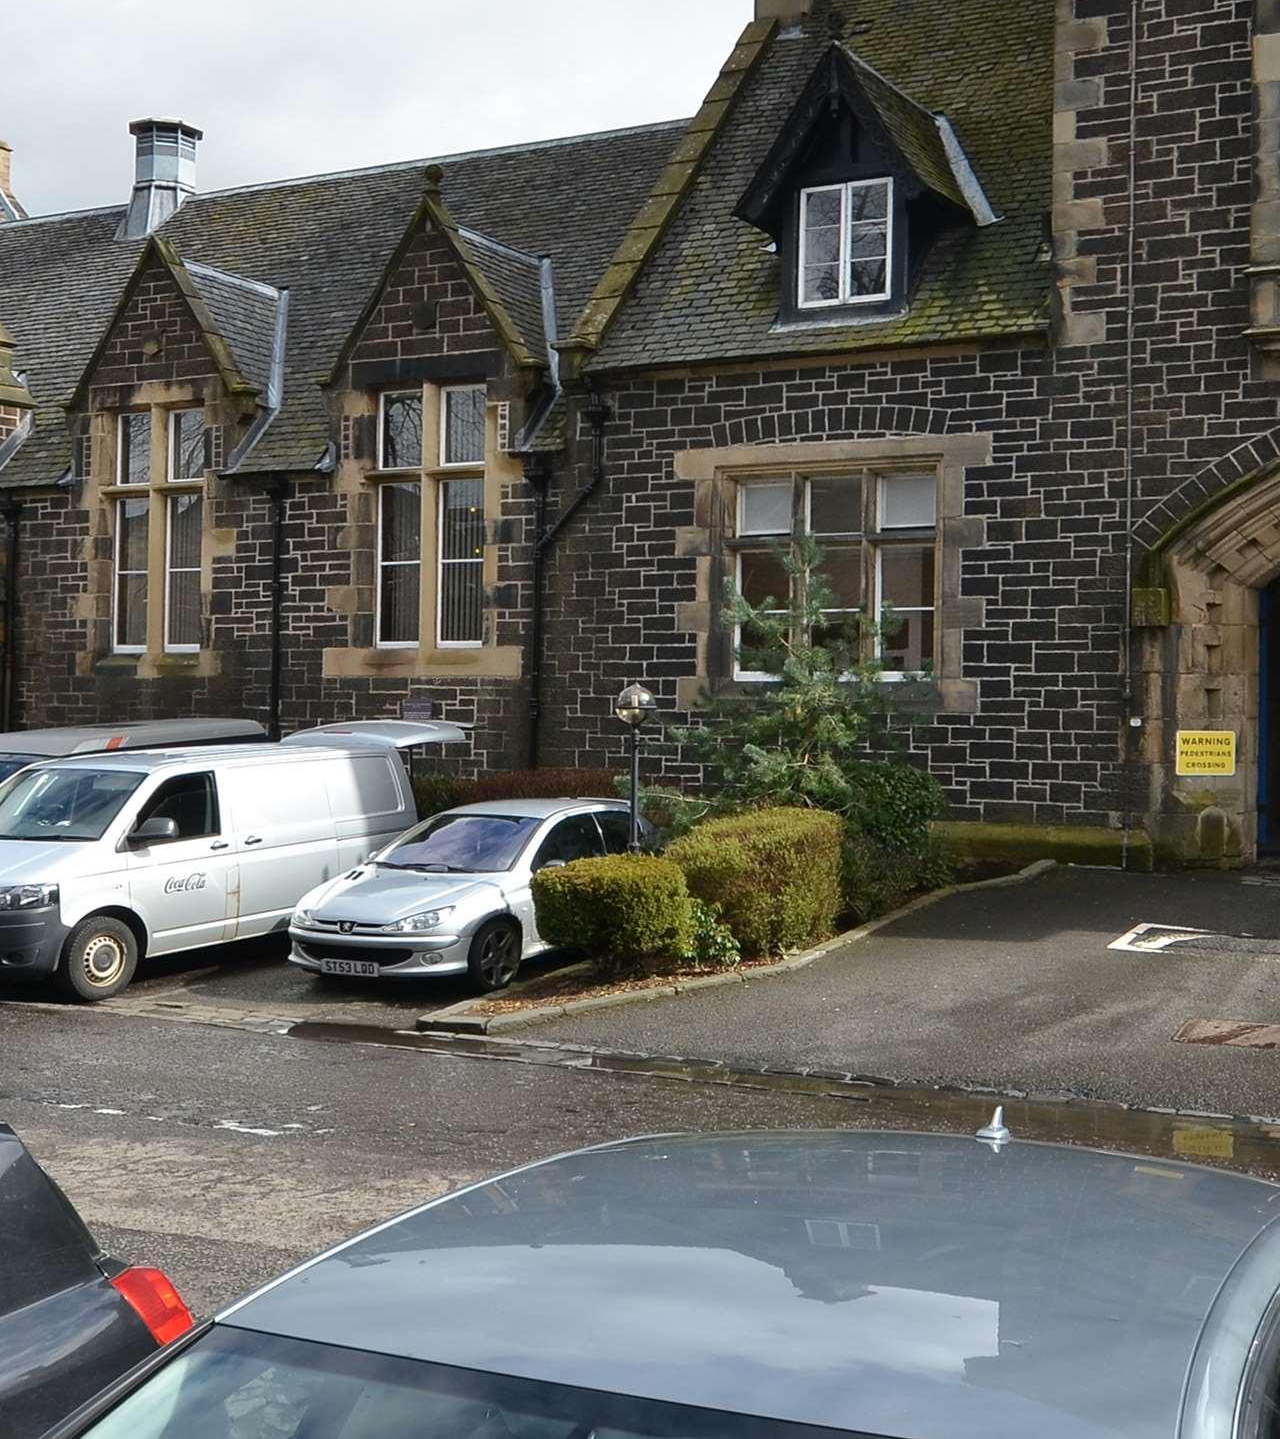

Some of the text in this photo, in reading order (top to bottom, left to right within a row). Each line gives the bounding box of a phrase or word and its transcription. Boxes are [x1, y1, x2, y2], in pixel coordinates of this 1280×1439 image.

[1181, 737, 1231, 746] WARNING
[1185, 761, 1226, 769] CROSSING
[325, 960, 352, 973] ST53
